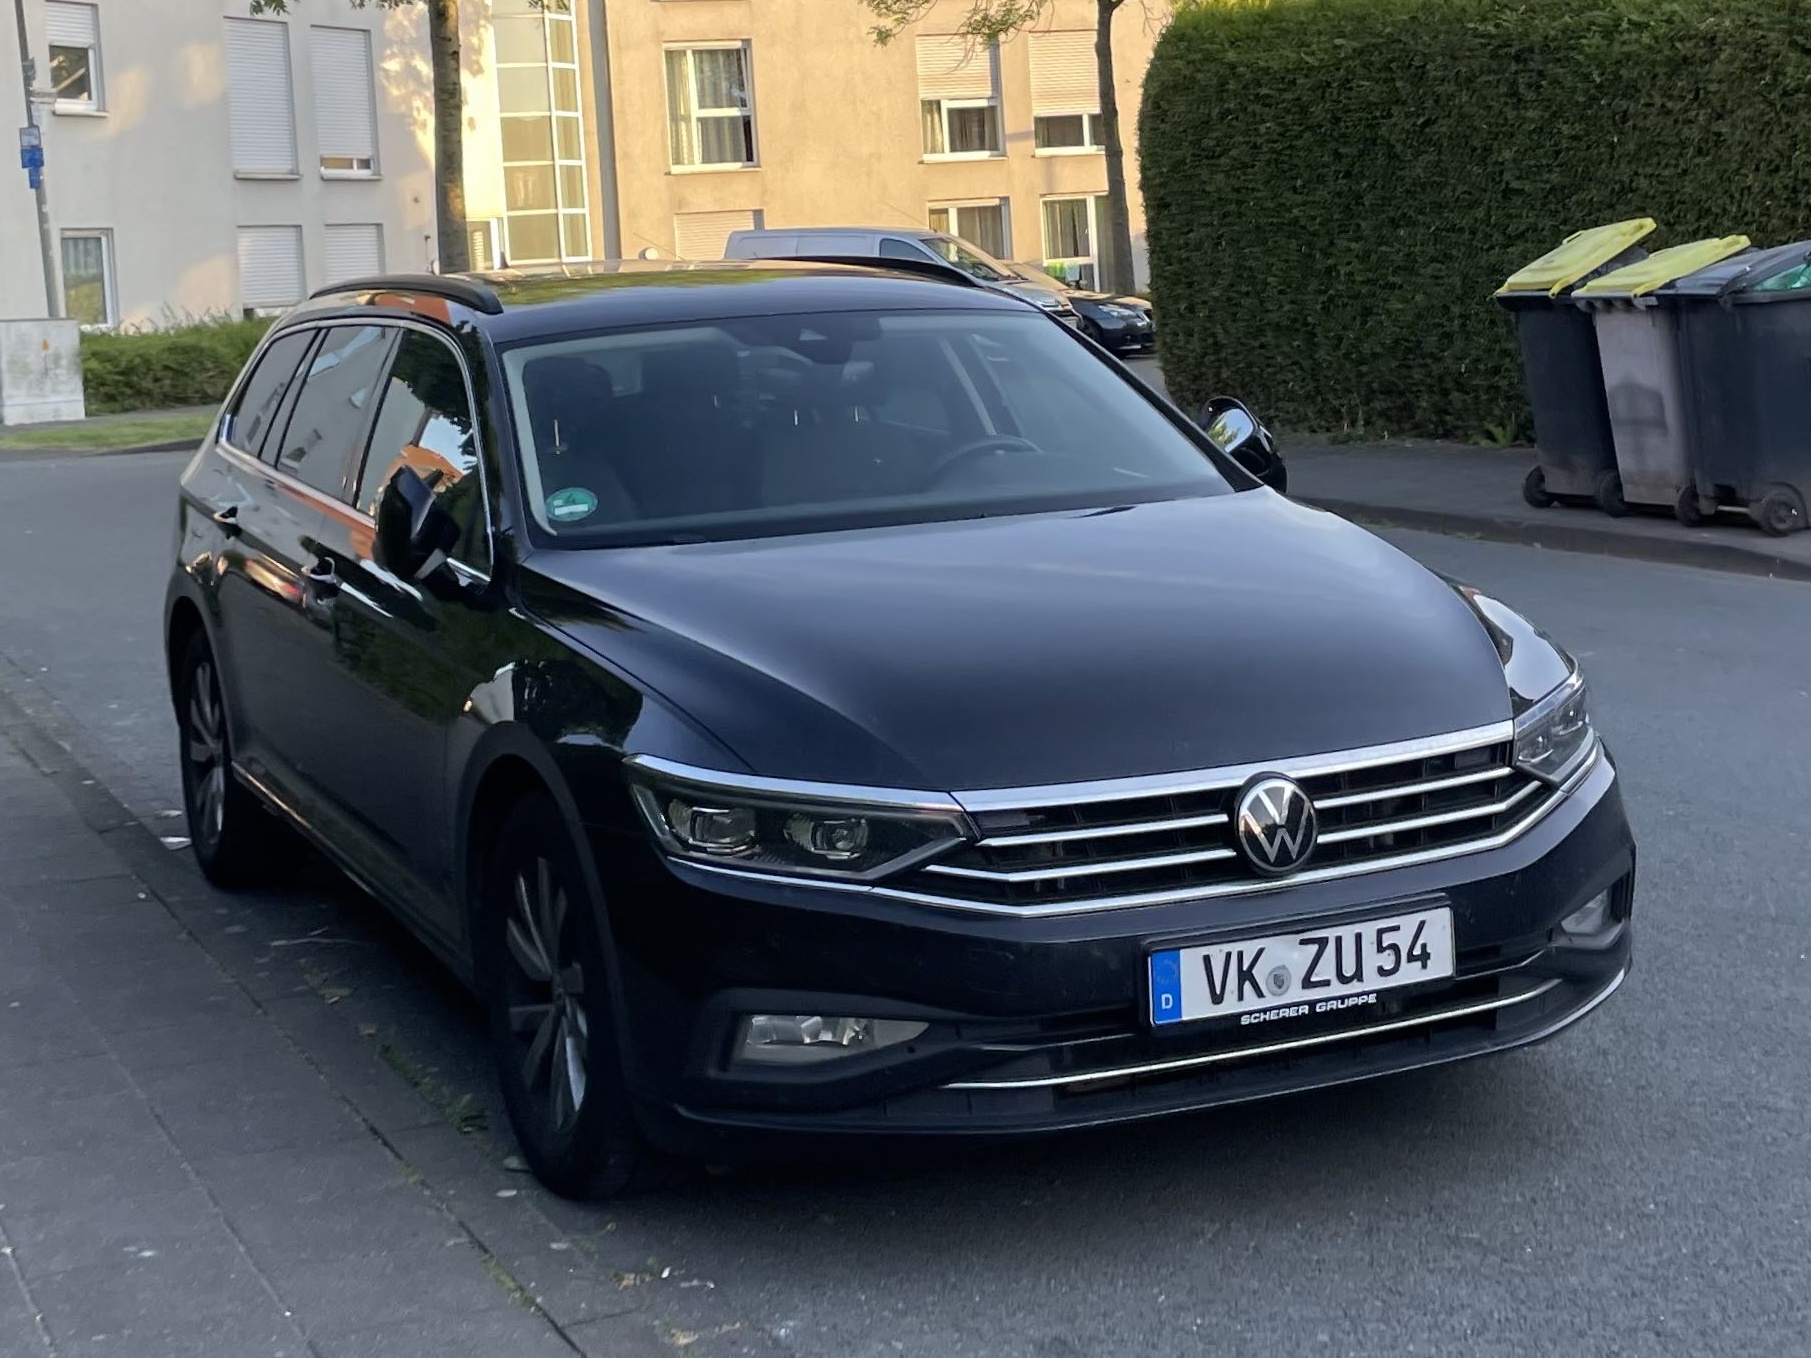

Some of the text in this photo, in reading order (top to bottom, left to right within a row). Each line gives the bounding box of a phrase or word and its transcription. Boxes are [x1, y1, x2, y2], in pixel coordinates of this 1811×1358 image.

[1239, 780, 1314, 868] VW
[1203, 919, 1431, 1005] VK ZU 54
[1161, 993, 1173, 1009] D
[1240, 993, 1377, 1025] SCHERER GRUPPE
